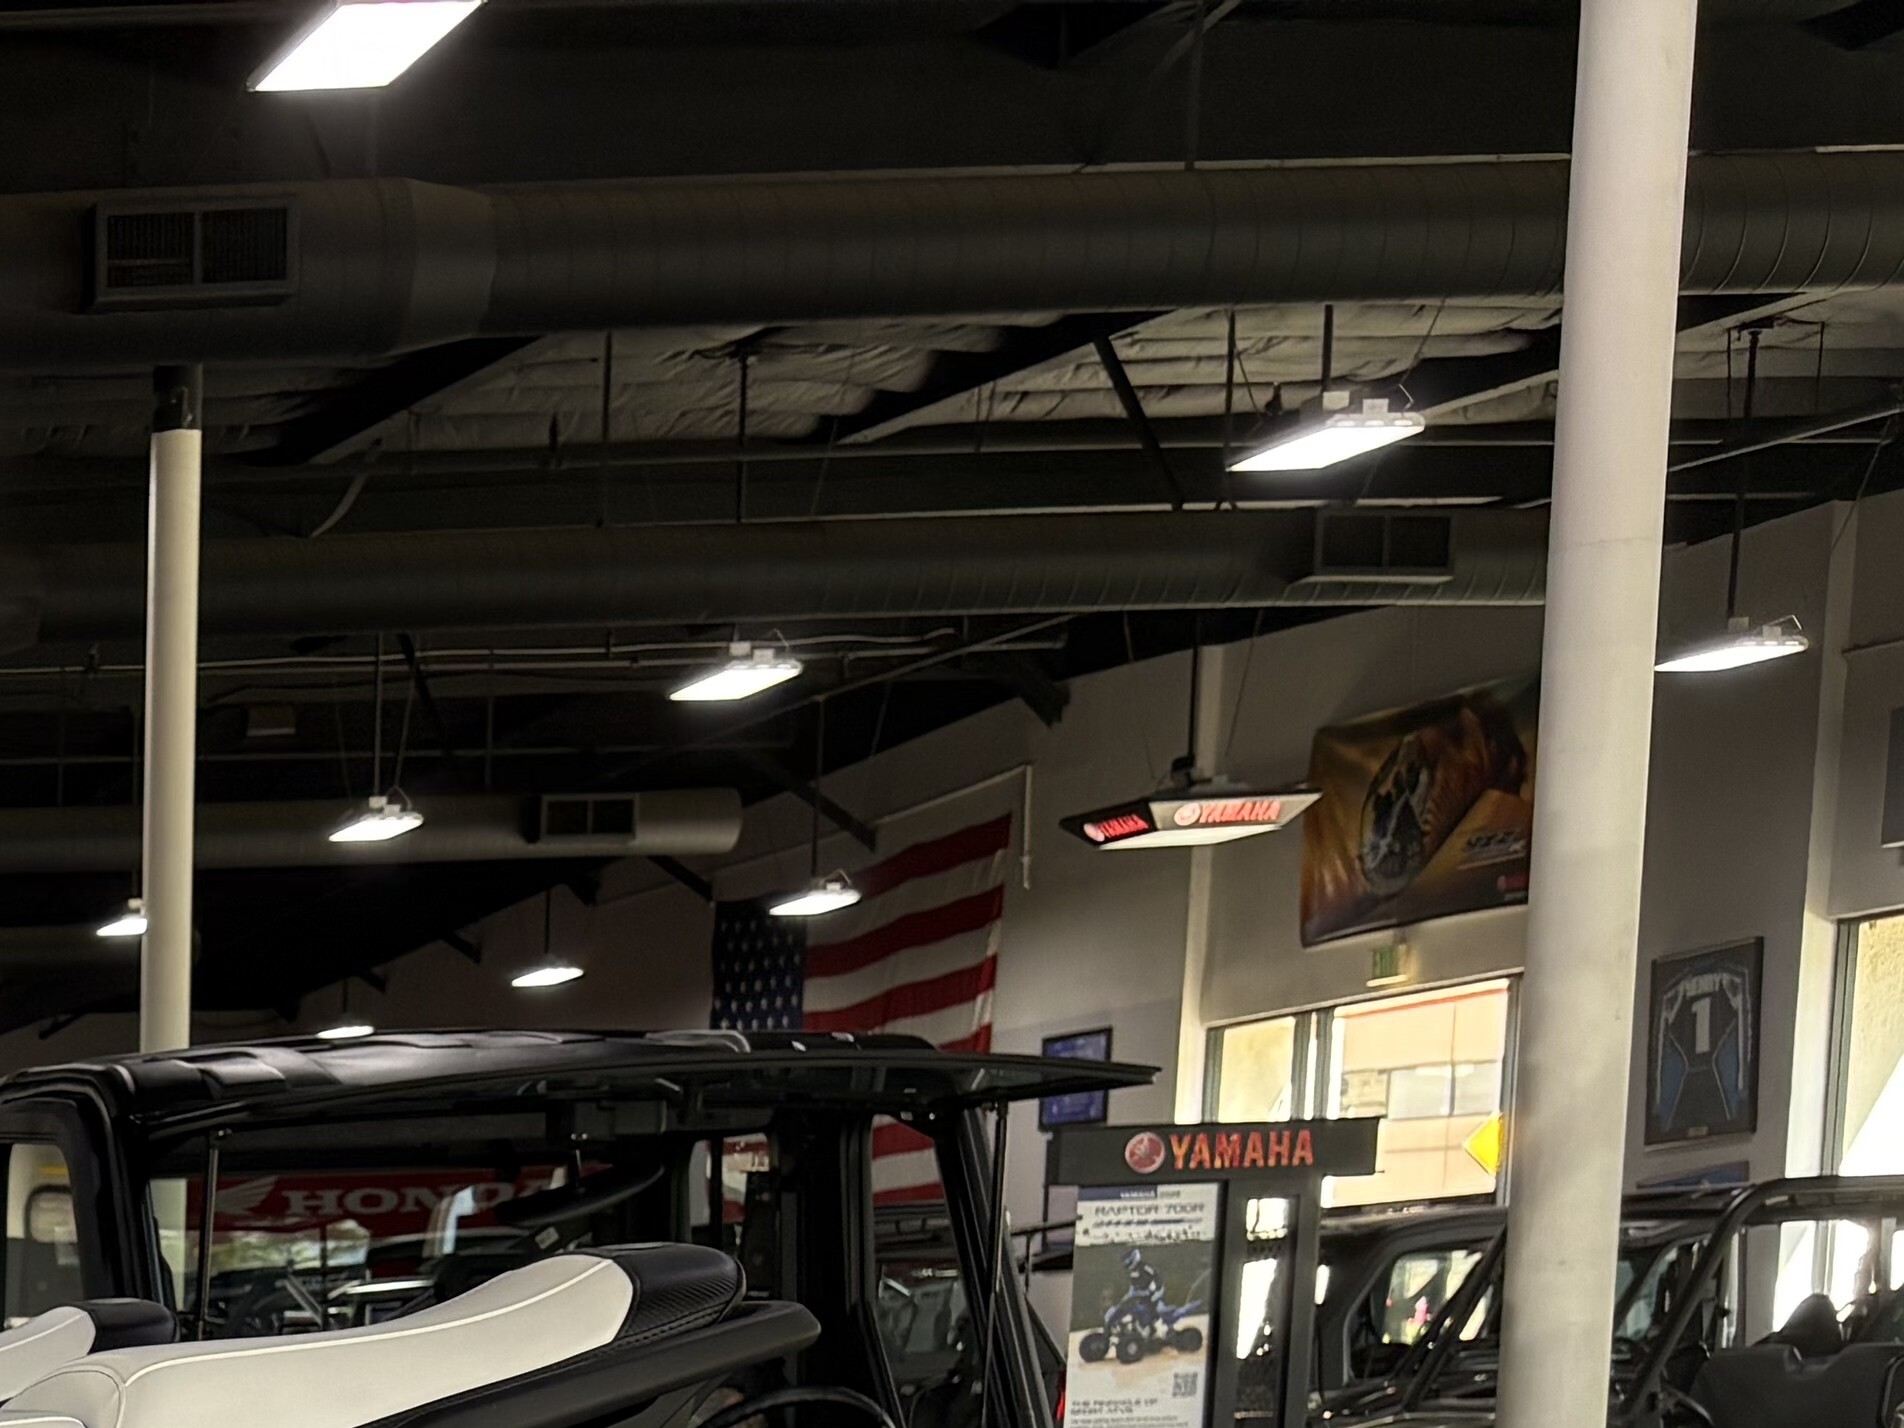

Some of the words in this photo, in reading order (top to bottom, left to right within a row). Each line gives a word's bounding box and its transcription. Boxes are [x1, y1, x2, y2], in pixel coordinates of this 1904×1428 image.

[1199, 800, 1282, 824] YAMAHA
[1692, 997, 1712, 1054] 1
[1170, 1128, 1314, 1171] YAMAHA
[282, 1178, 558, 1216] HOND
[1094, 1204, 1160, 1217] RAPTOR
